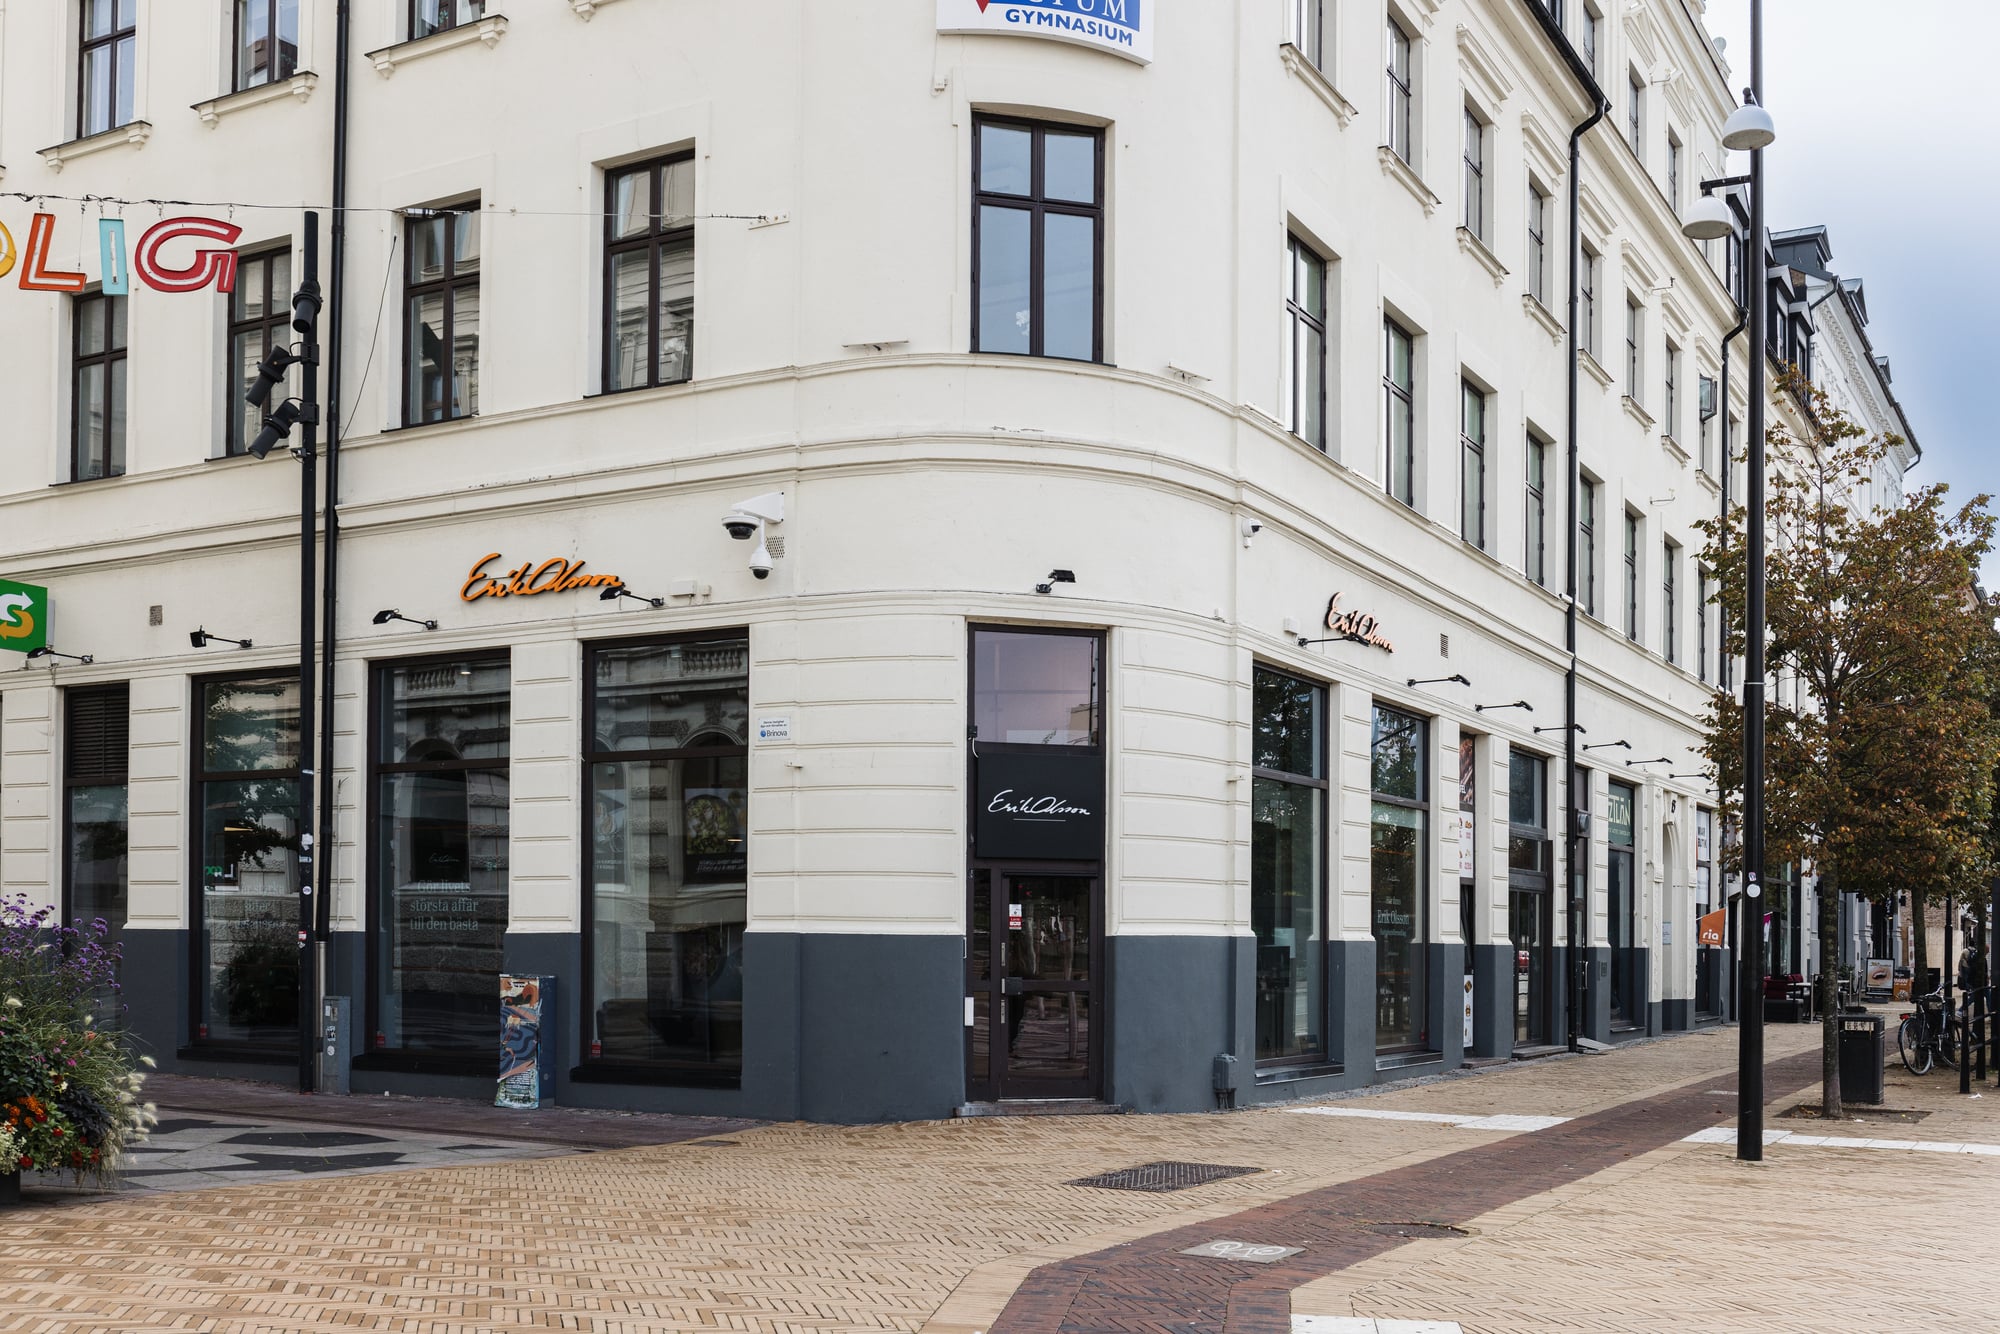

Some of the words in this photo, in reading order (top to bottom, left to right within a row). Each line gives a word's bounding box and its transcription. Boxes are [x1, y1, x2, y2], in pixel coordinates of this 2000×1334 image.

[1005, 9, 1133, 46] GYMNASIUM
[0, 212, 243, 296] LIG
[988, 789, 1033, 813] Erik
[1031, 796, 1091, 816] Olsson
[442, 879, 470, 892] livets
[410, 898, 449, 912] största
[451, 897, 479, 912] affär
[410, 916, 425, 930] till
[426, 917, 448, 930] den
[449, 917, 479, 931] bästa
[1702, 928, 1719, 941] ria
